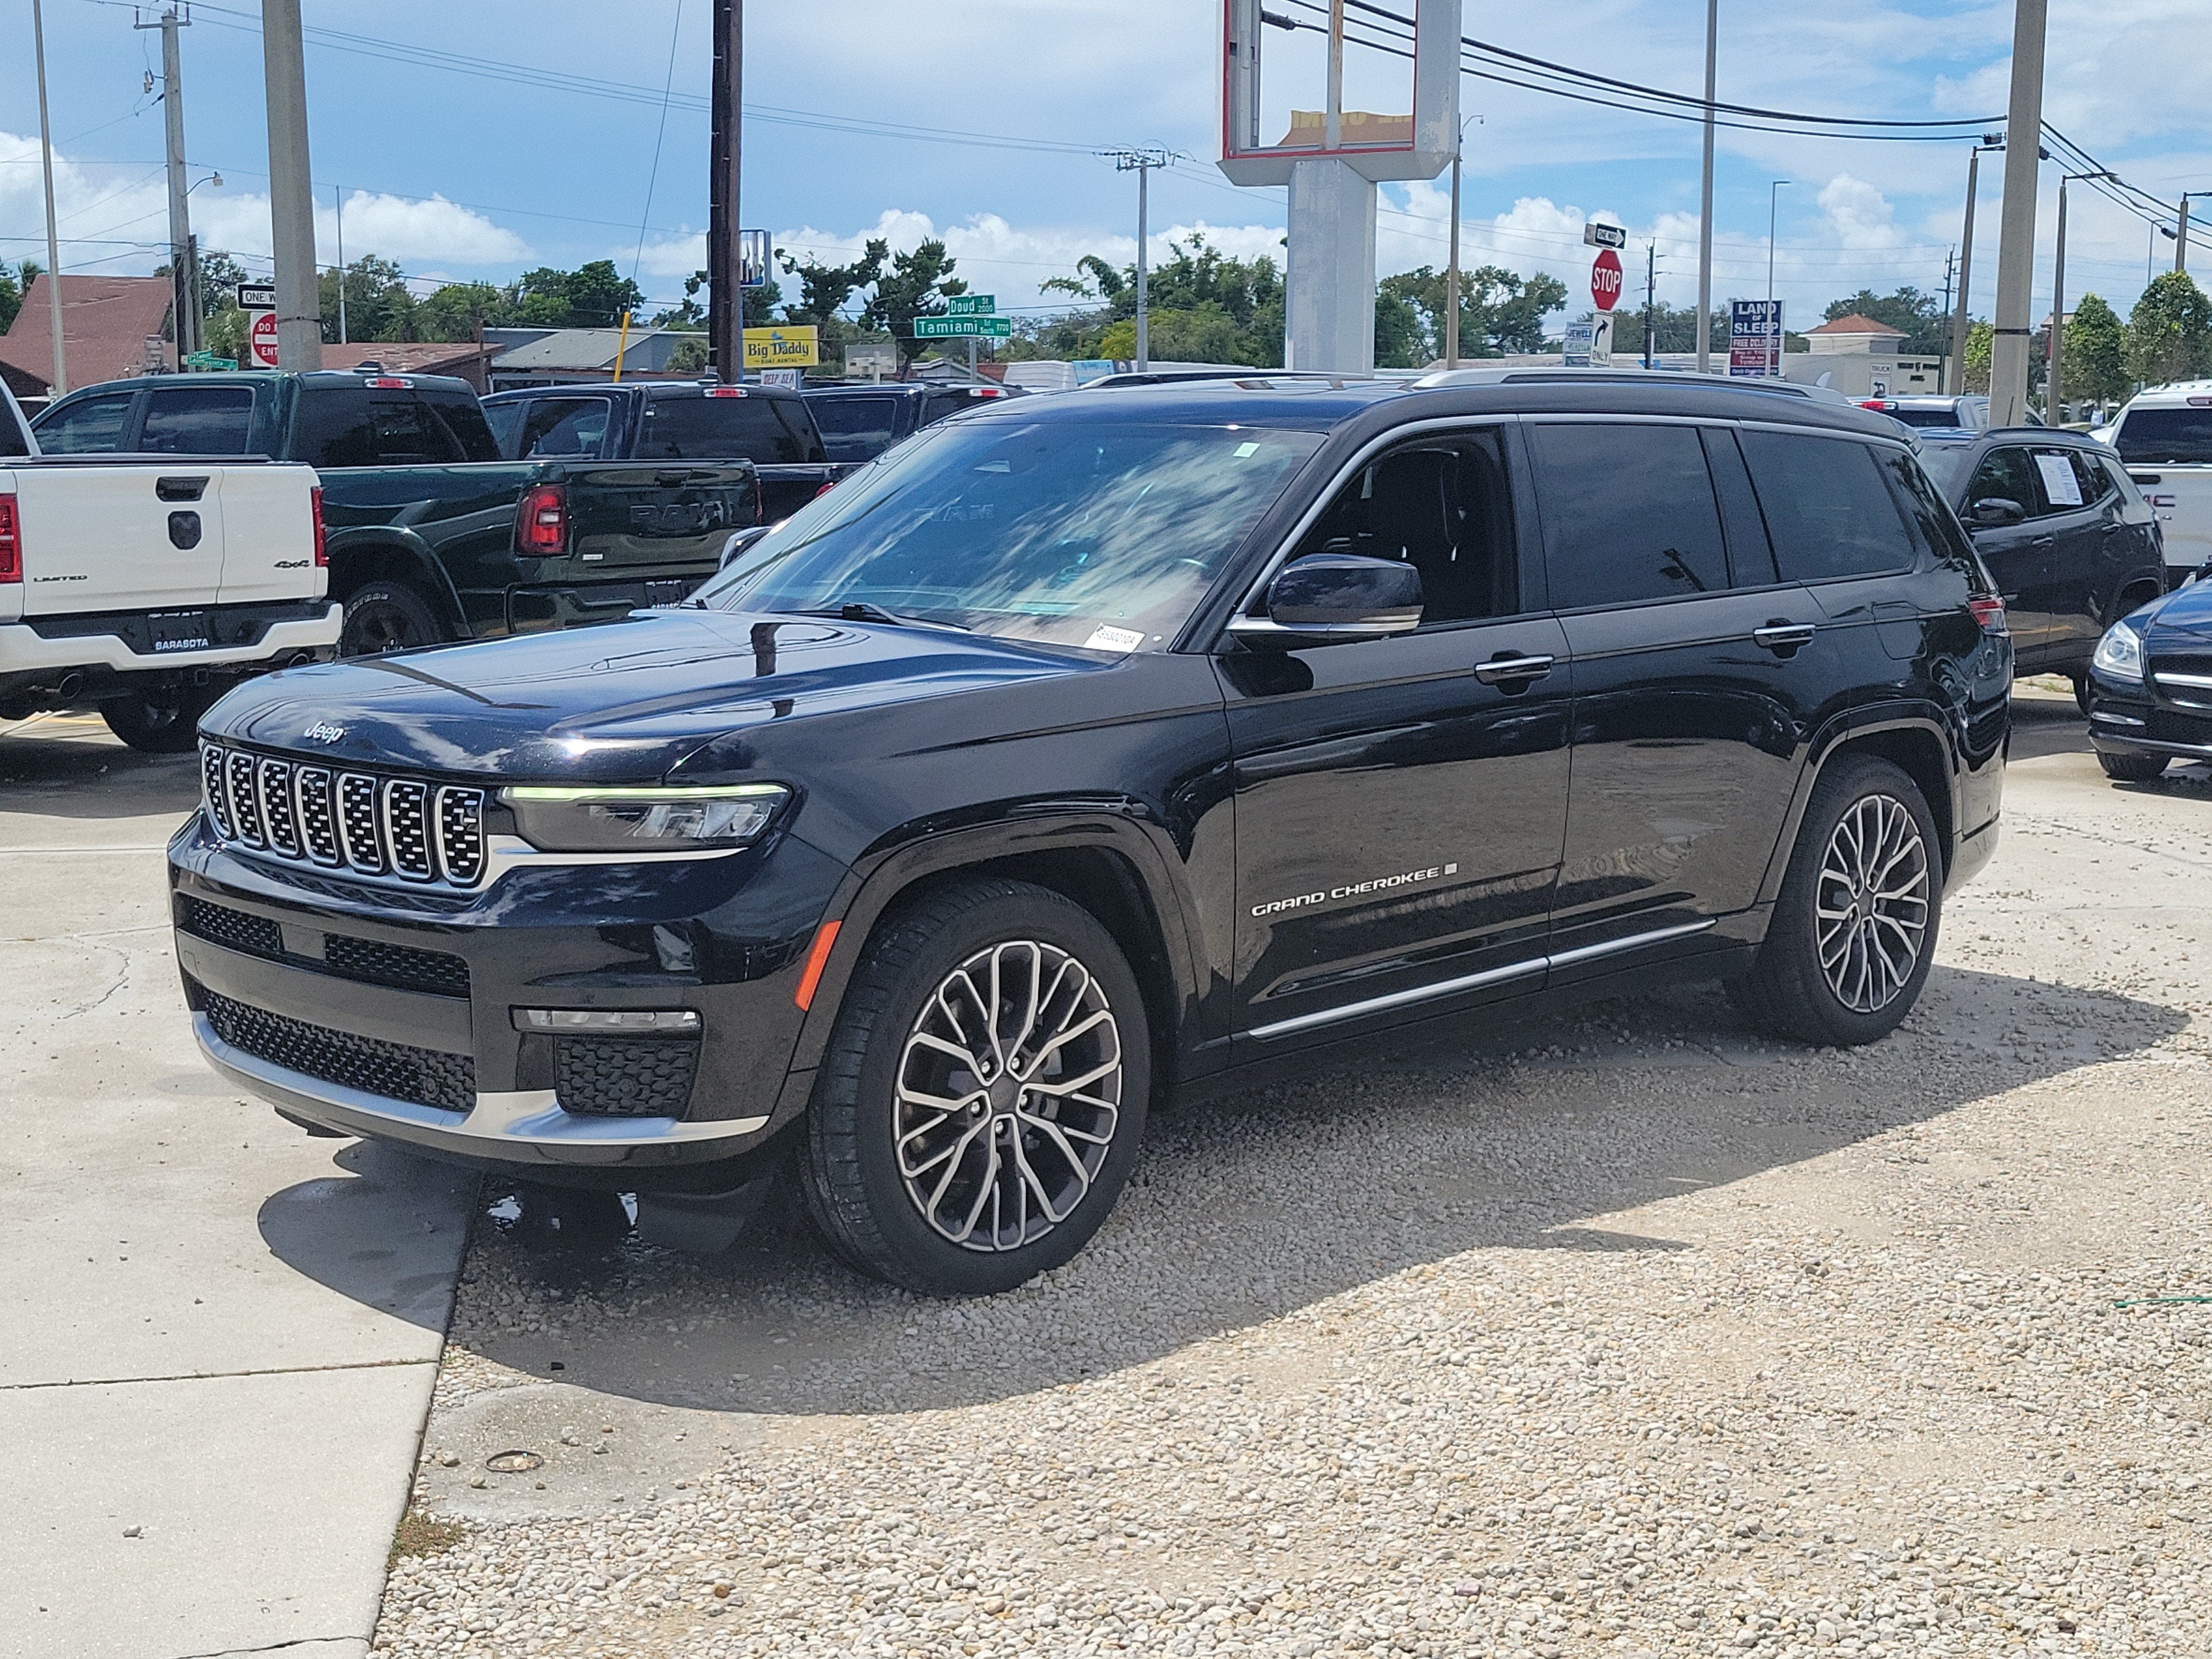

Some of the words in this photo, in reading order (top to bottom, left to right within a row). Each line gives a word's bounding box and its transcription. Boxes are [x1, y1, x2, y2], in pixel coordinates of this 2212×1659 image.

[1593, 267, 1621, 293] STOP
[245, 292, 265, 302] ONE
[951, 299, 975, 313] Doud
[1738, 303, 1777, 315] LAND
[258, 323, 271, 332] DO
[918, 320, 978, 334] Tamiami
[1734, 321, 1779, 334] SLEEP
[262, 347, 278, 356] ENT
[748, 343, 768, 358] Big
[770, 341, 809, 357] Daddy
[1592, 350, 1608, 362] ONLY
[155, 637, 209, 650] SARASOTA
[303, 720, 344, 744] Jeep
[1251, 891, 1325, 917] GRAND
[1330, 867, 1440, 899] CHEROKEE
